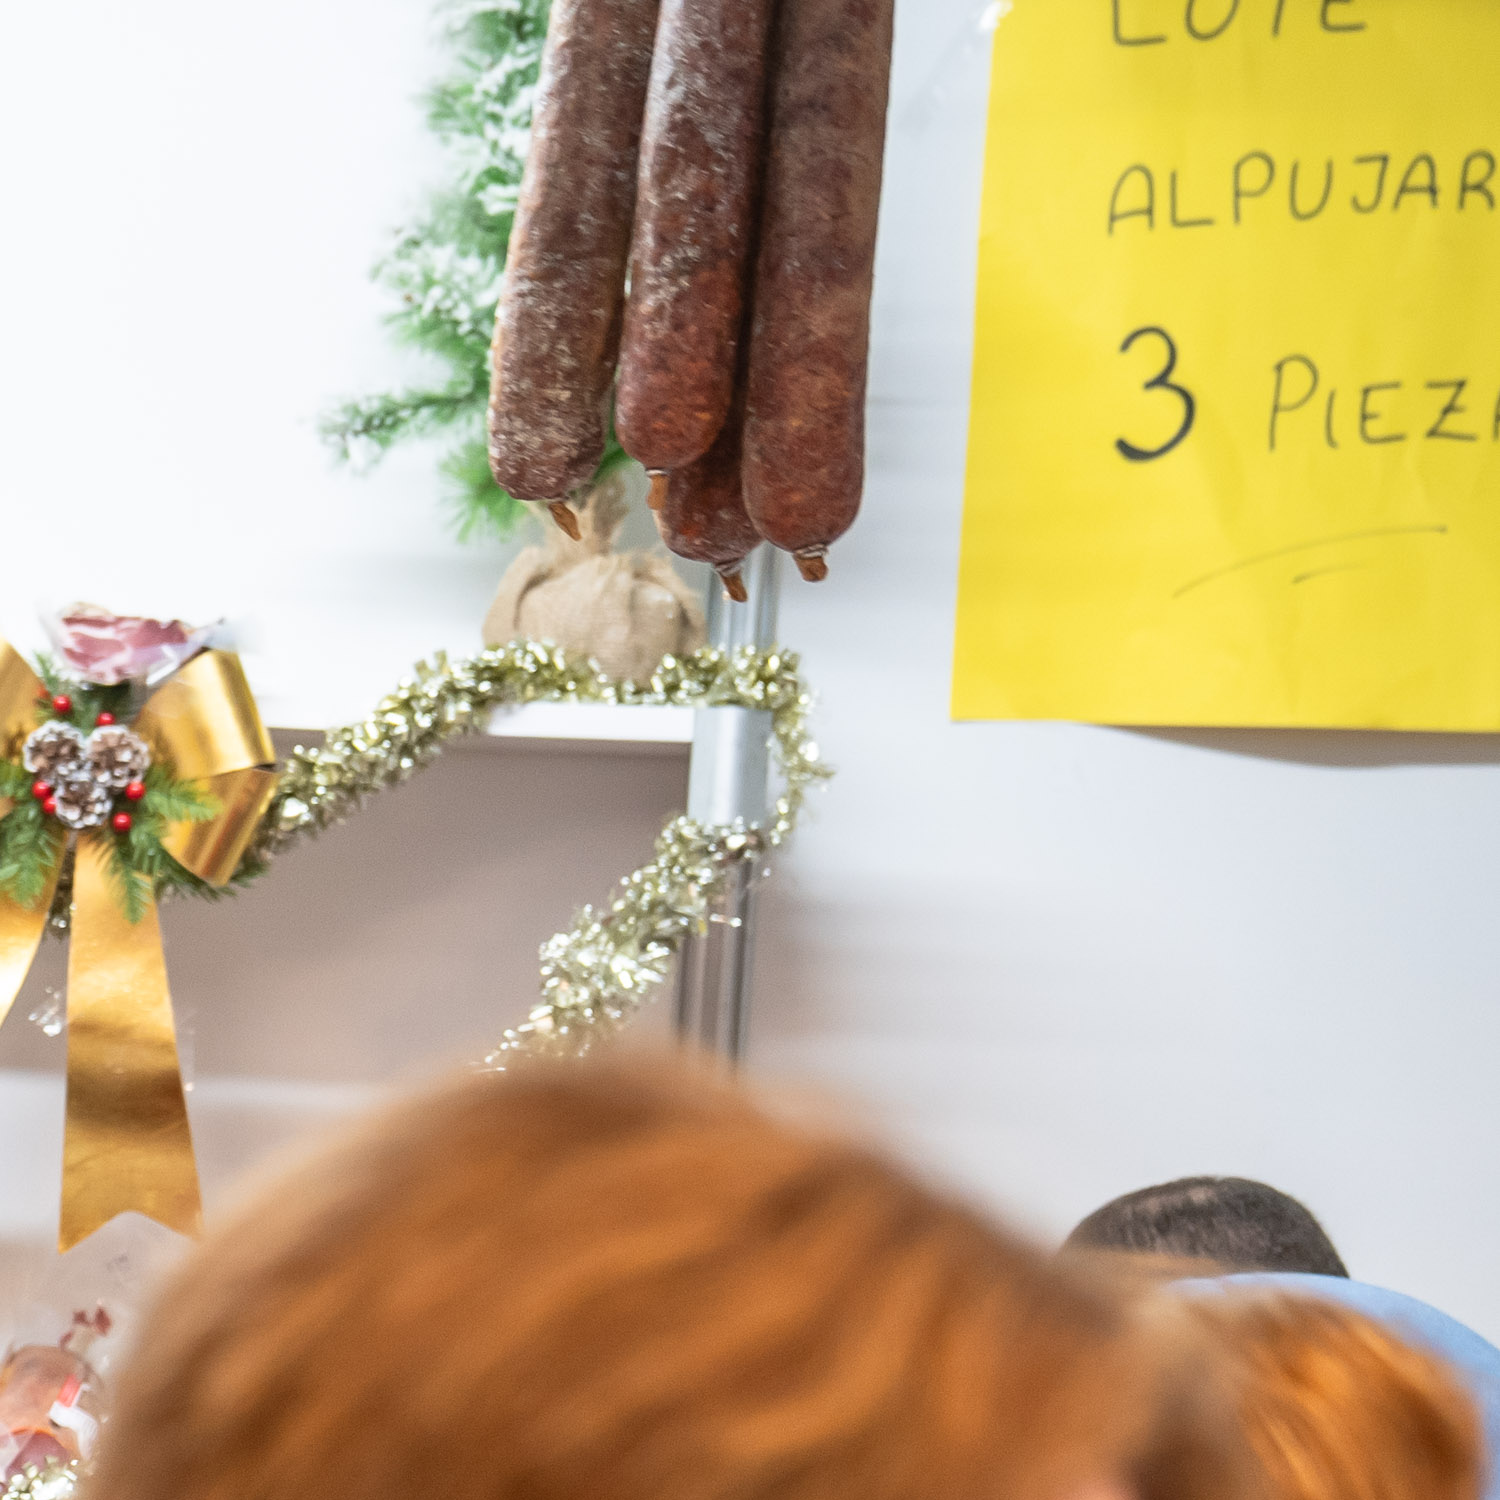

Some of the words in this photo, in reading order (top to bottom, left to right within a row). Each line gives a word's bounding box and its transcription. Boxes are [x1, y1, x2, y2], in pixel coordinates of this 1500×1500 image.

[1106, 149, 1498, 237] ALPUJAR
[1113, 324, 1197, 464] 3
[1267, 353, 1500, 452] PIEZ
